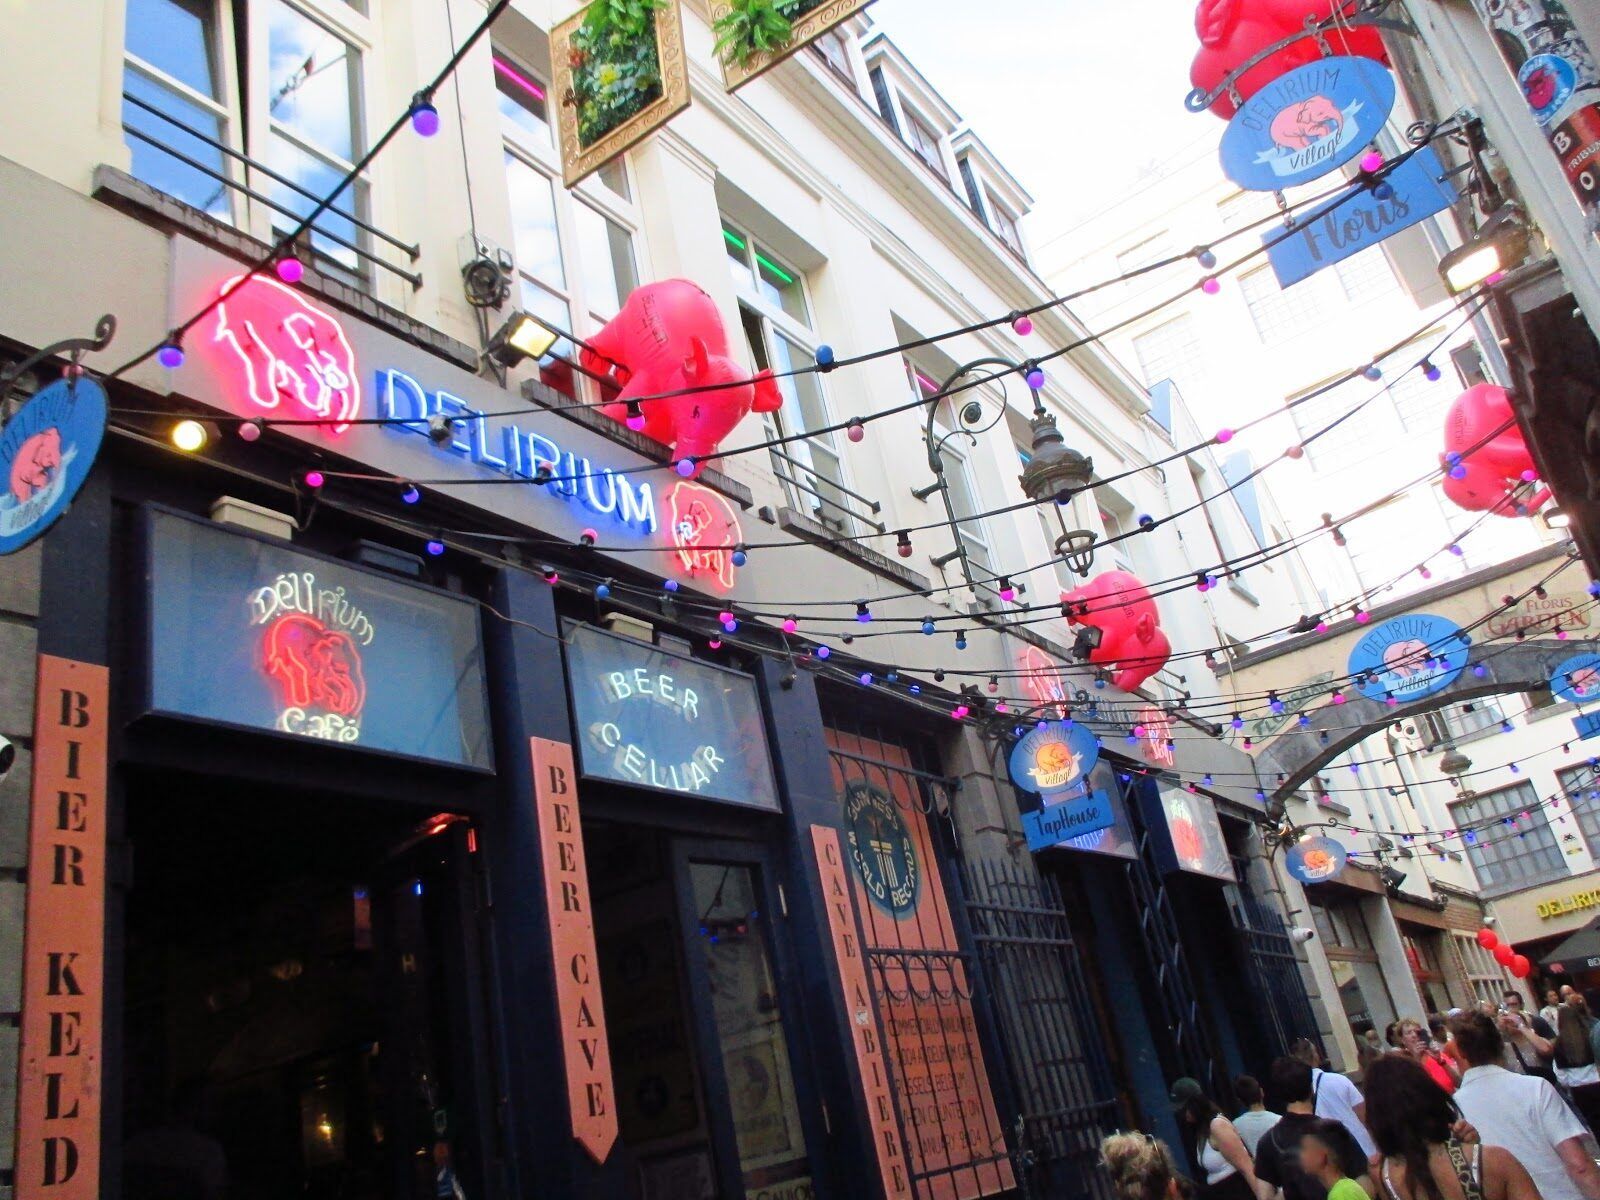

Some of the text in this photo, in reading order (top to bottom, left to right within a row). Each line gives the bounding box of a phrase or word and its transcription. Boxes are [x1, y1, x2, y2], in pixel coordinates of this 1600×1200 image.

[1242, 67, 1341, 132] DELIRIUM
[1290, 131, 1343, 171] Village
[1301, 193, 1410, 262] Floris
[376, 368, 657, 534] DELIRIUM
[1488, 609, 1589, 636] GARDEN
[1526, 597, 1573, 612] FLORIS
[1362, 619, 1433, 656] DELIRIUM
[611, 668, 698, 719] BEER
[1397, 670, 1434, 691] Village
[282, 707, 359, 742] Café
[1023, 727, 1074, 755] DELIRIUM
[601, 723, 725, 791] CELLAR
[1033, 805, 1100, 839] TapHouse
[825, 843, 856, 958] CAVE
[41, 689, 90, 1187] BIER KELD
[548, 765, 605, 1117] BEER CAVE
